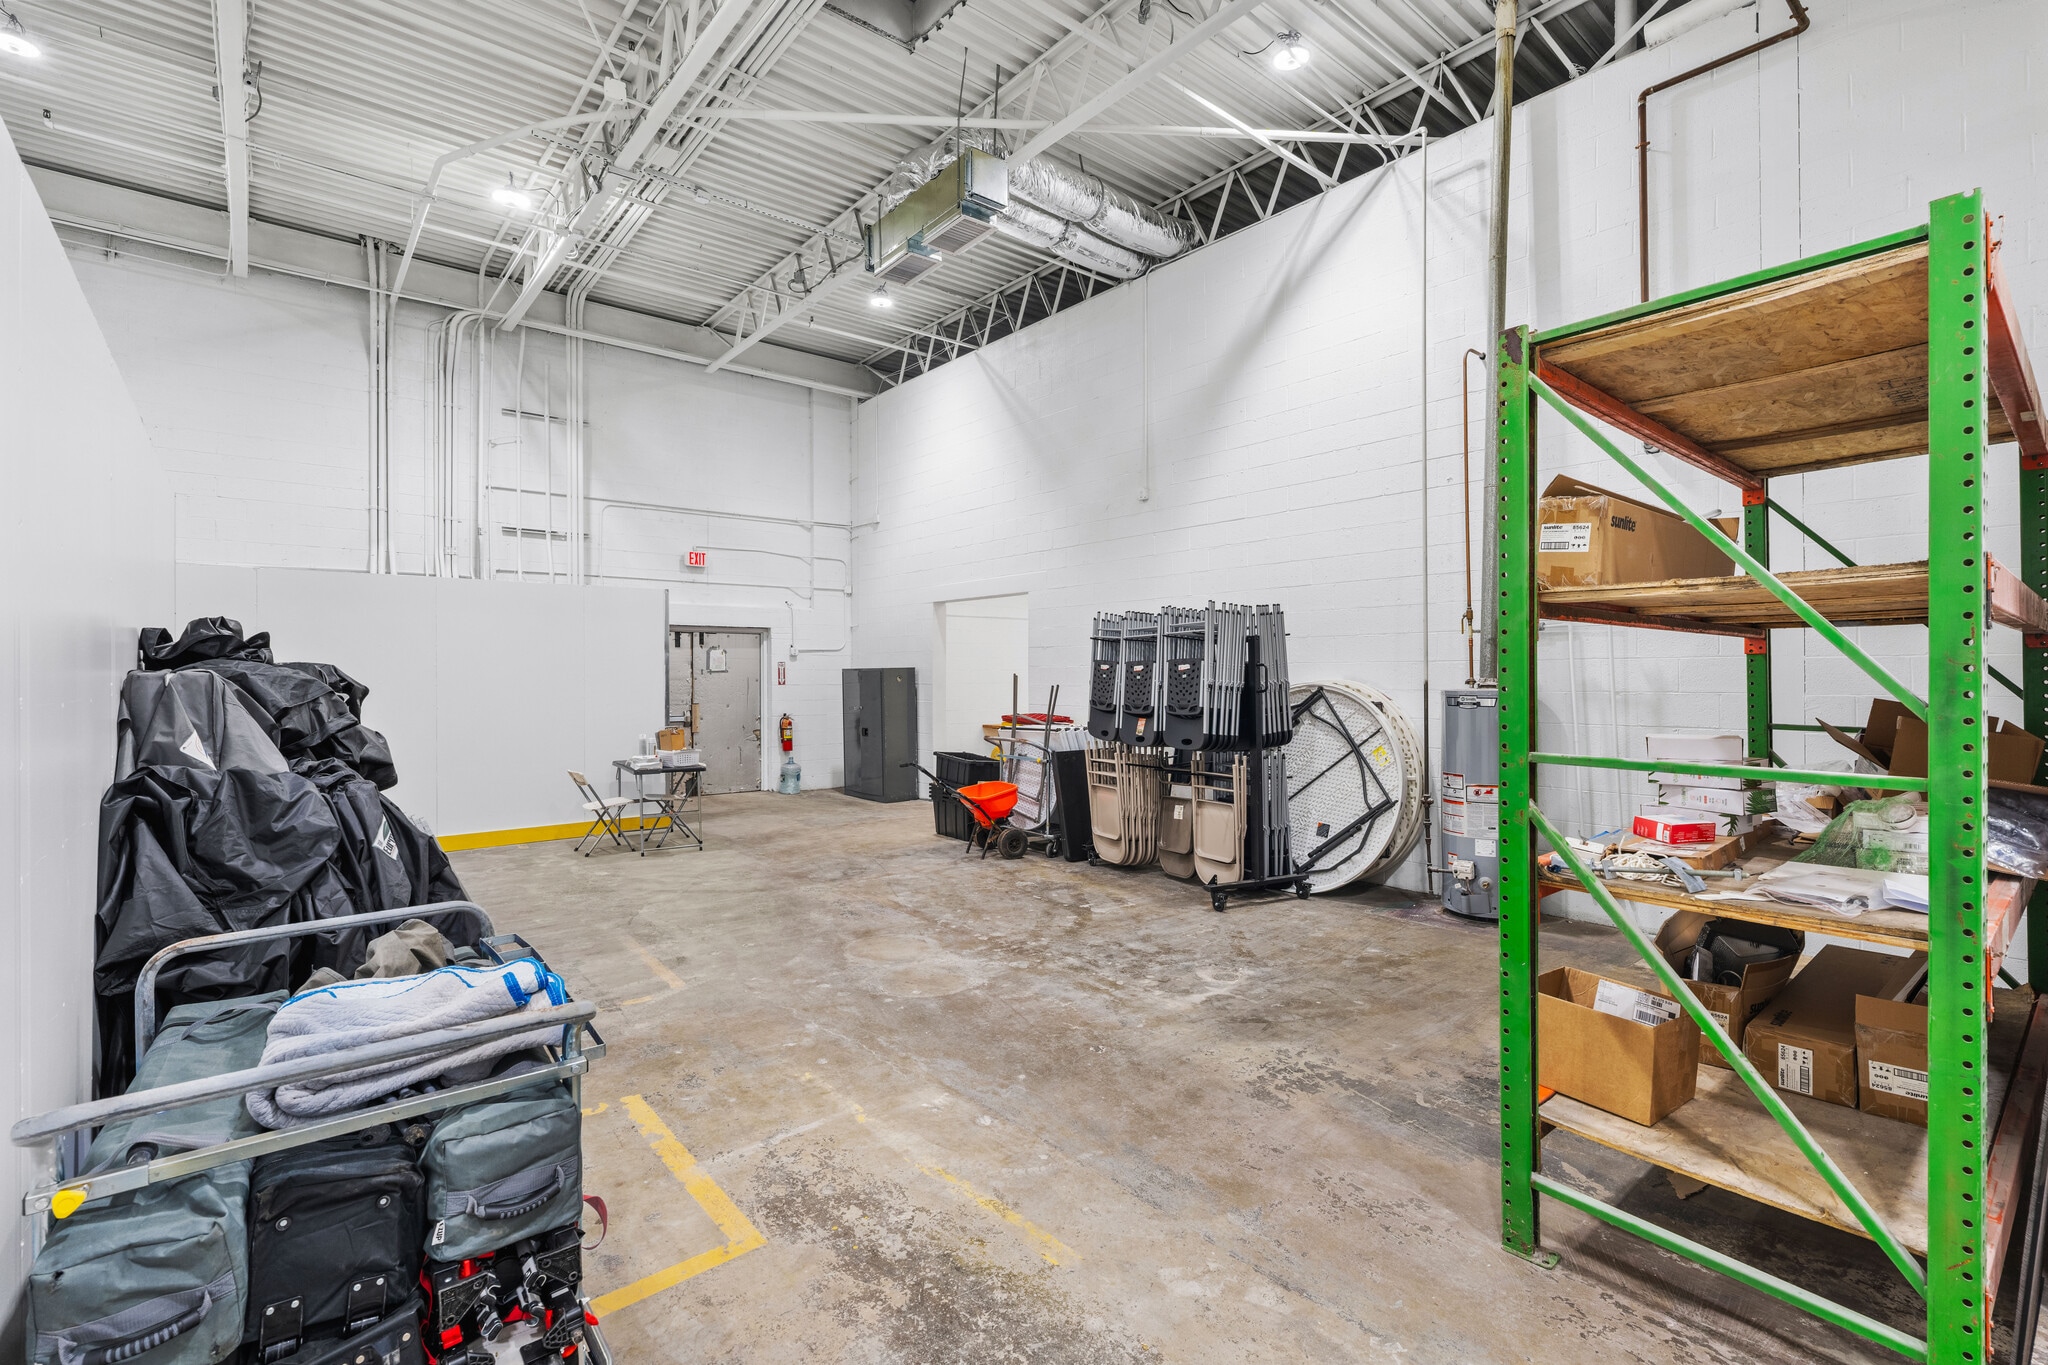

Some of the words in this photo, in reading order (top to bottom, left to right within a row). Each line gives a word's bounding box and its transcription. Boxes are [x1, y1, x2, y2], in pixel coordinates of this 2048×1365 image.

[1611, 515, 1636, 532] sunlite
[689, 551, 706, 566] EXIT
[1871, 1082, 1893, 1091] 85624
[1905, 1091, 1928, 1100] unlite
